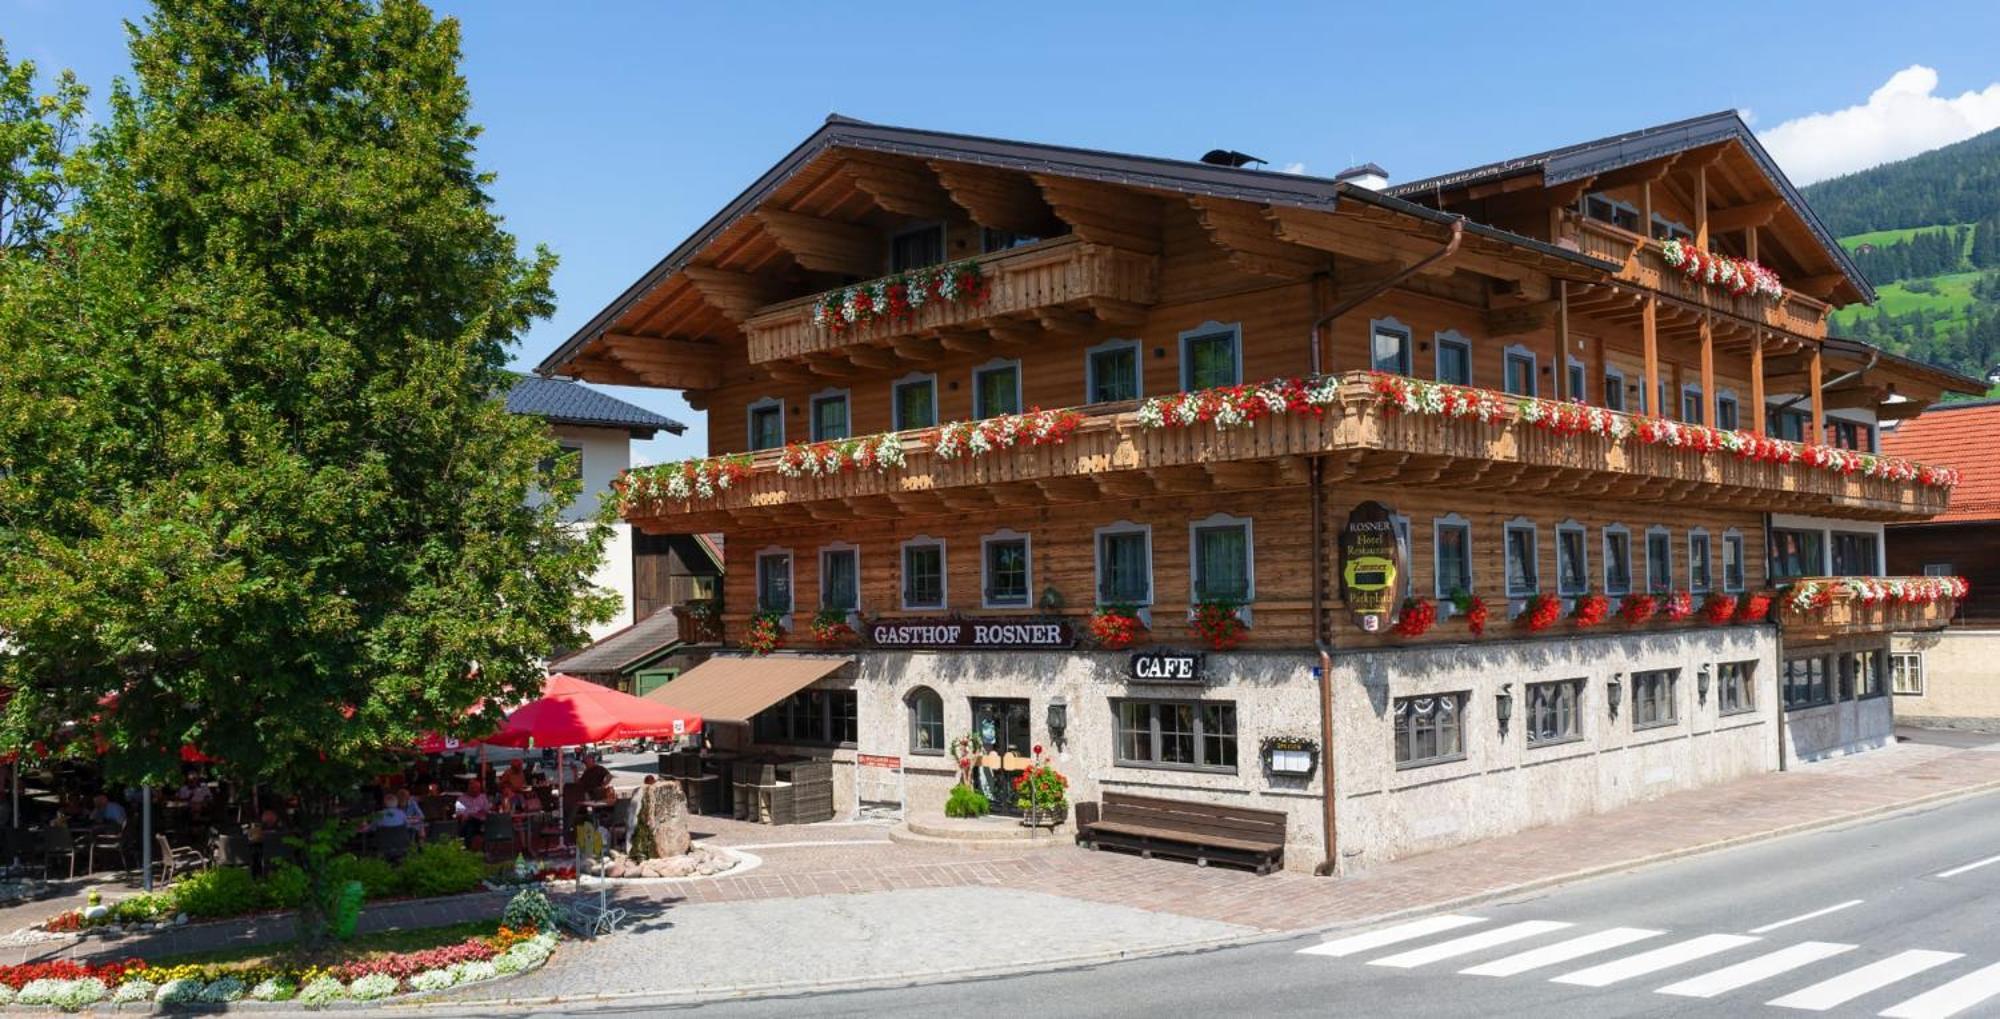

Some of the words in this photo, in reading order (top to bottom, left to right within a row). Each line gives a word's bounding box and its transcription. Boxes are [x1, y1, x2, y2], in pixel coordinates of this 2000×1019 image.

[1349, 521, 1391, 532] ROSNER
[1357, 534, 1383, 545] Hotel
[874, 625, 960, 644] GASTHOF
[974, 625, 1062, 644] ROSNER
[1136, 657, 1193, 678] CAFE
